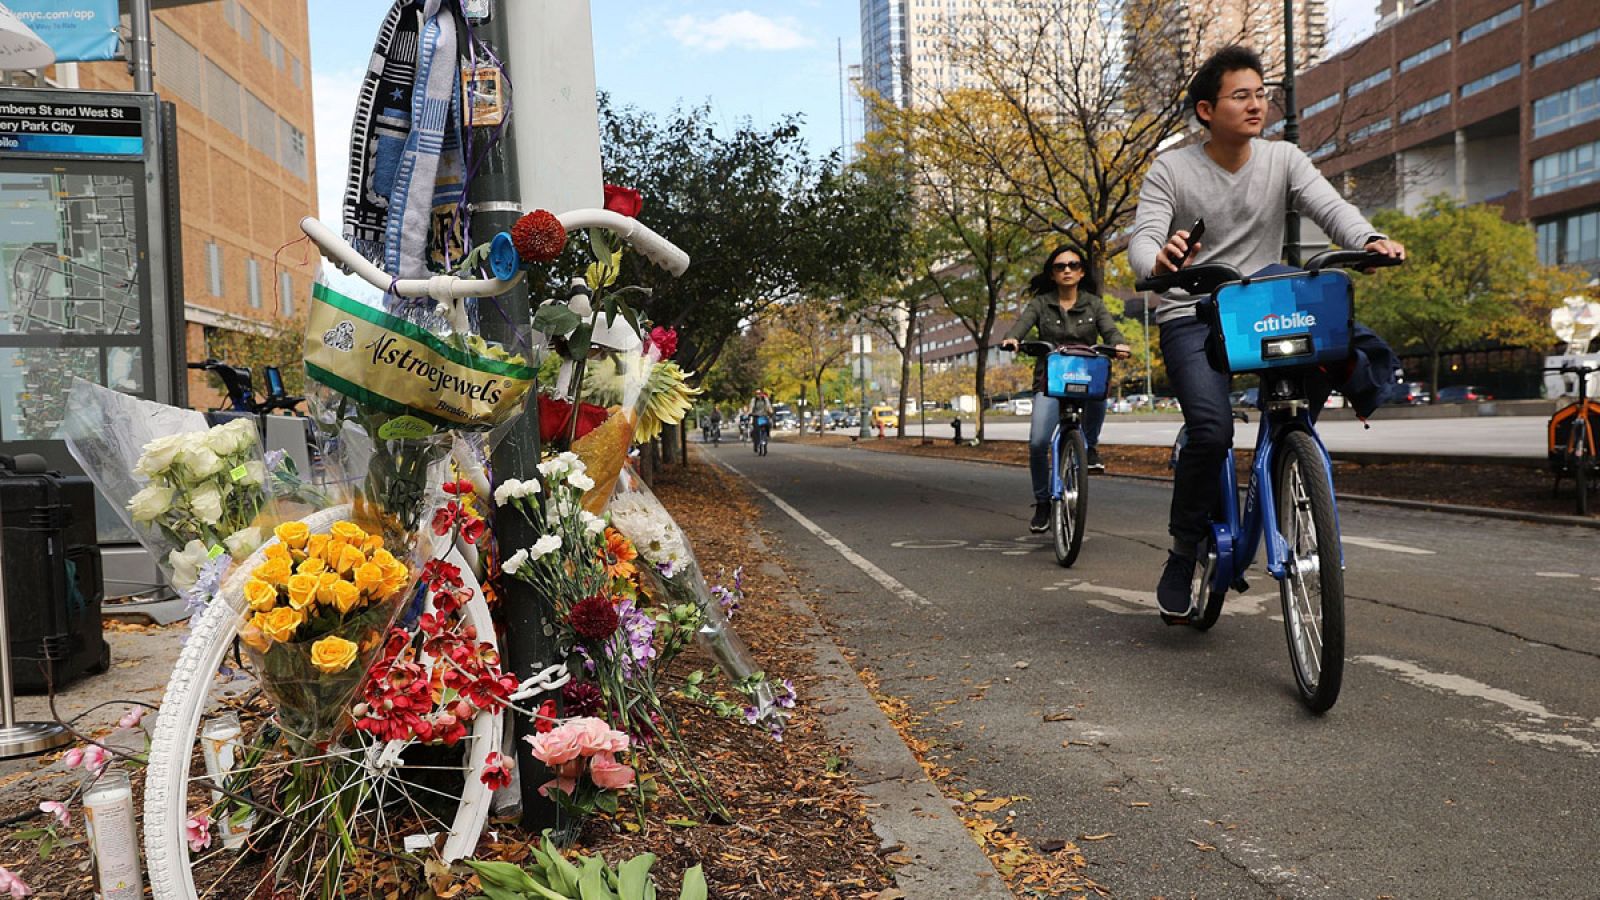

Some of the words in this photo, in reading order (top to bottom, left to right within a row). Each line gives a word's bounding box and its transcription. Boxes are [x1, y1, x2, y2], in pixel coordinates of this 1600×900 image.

[16, 9, 95, 21] enyc.com/app
[40, 105, 52, 115] St
[54, 106, 77, 116] and
[79, 107, 109, 118] West
[111, 108, 124, 118] St
[22, 120, 49, 132] Park
[51, 121, 75, 134] City
[1281, 311, 1316, 329] bike
[366, 332, 502, 404] Alstroejewels
